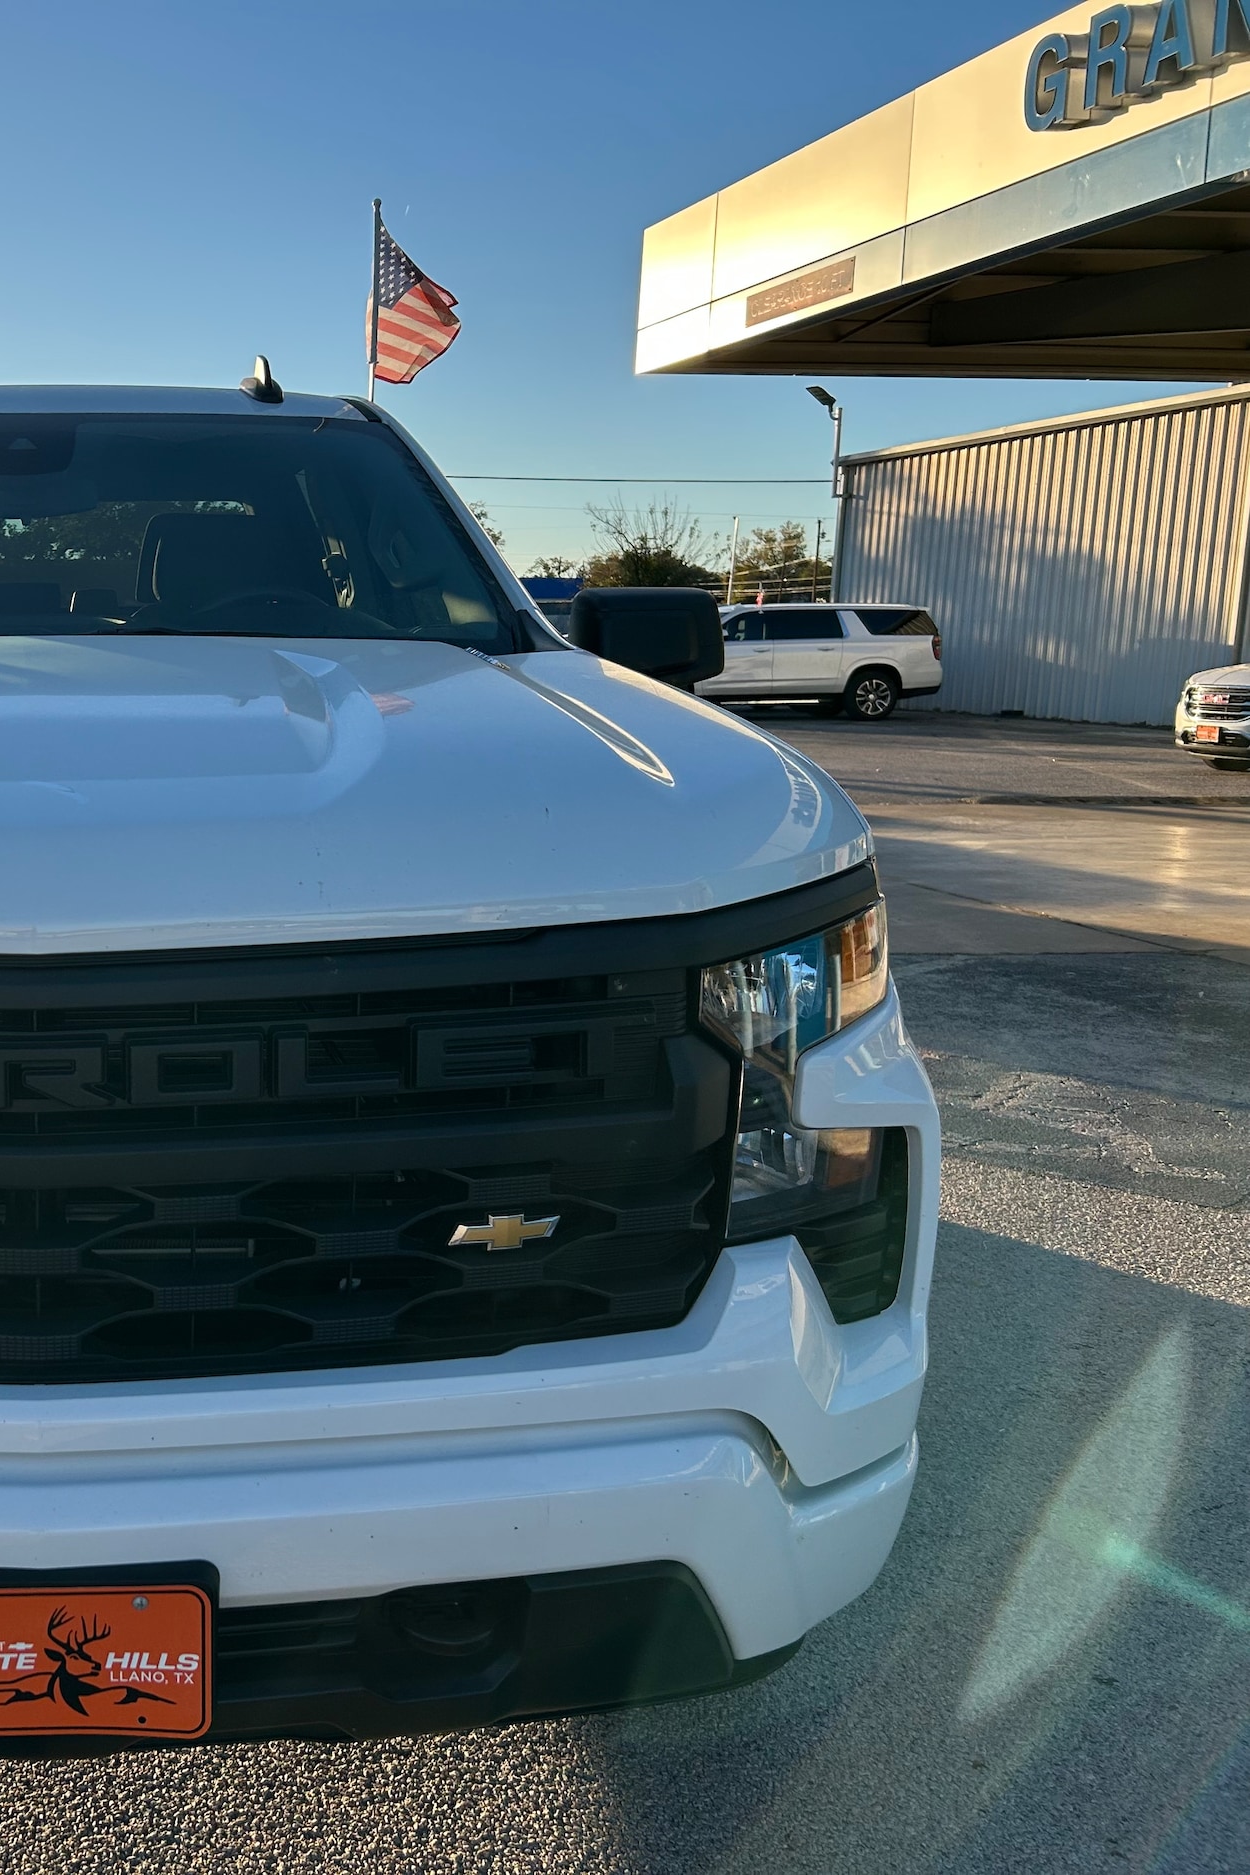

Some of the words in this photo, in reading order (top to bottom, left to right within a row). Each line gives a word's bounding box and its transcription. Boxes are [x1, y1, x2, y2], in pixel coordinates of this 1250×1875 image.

[105, 1651, 199, 1671] HILLS
[110, 1671, 169, 1684] LLANO,
[174, 1672, 195, 1684] TX
